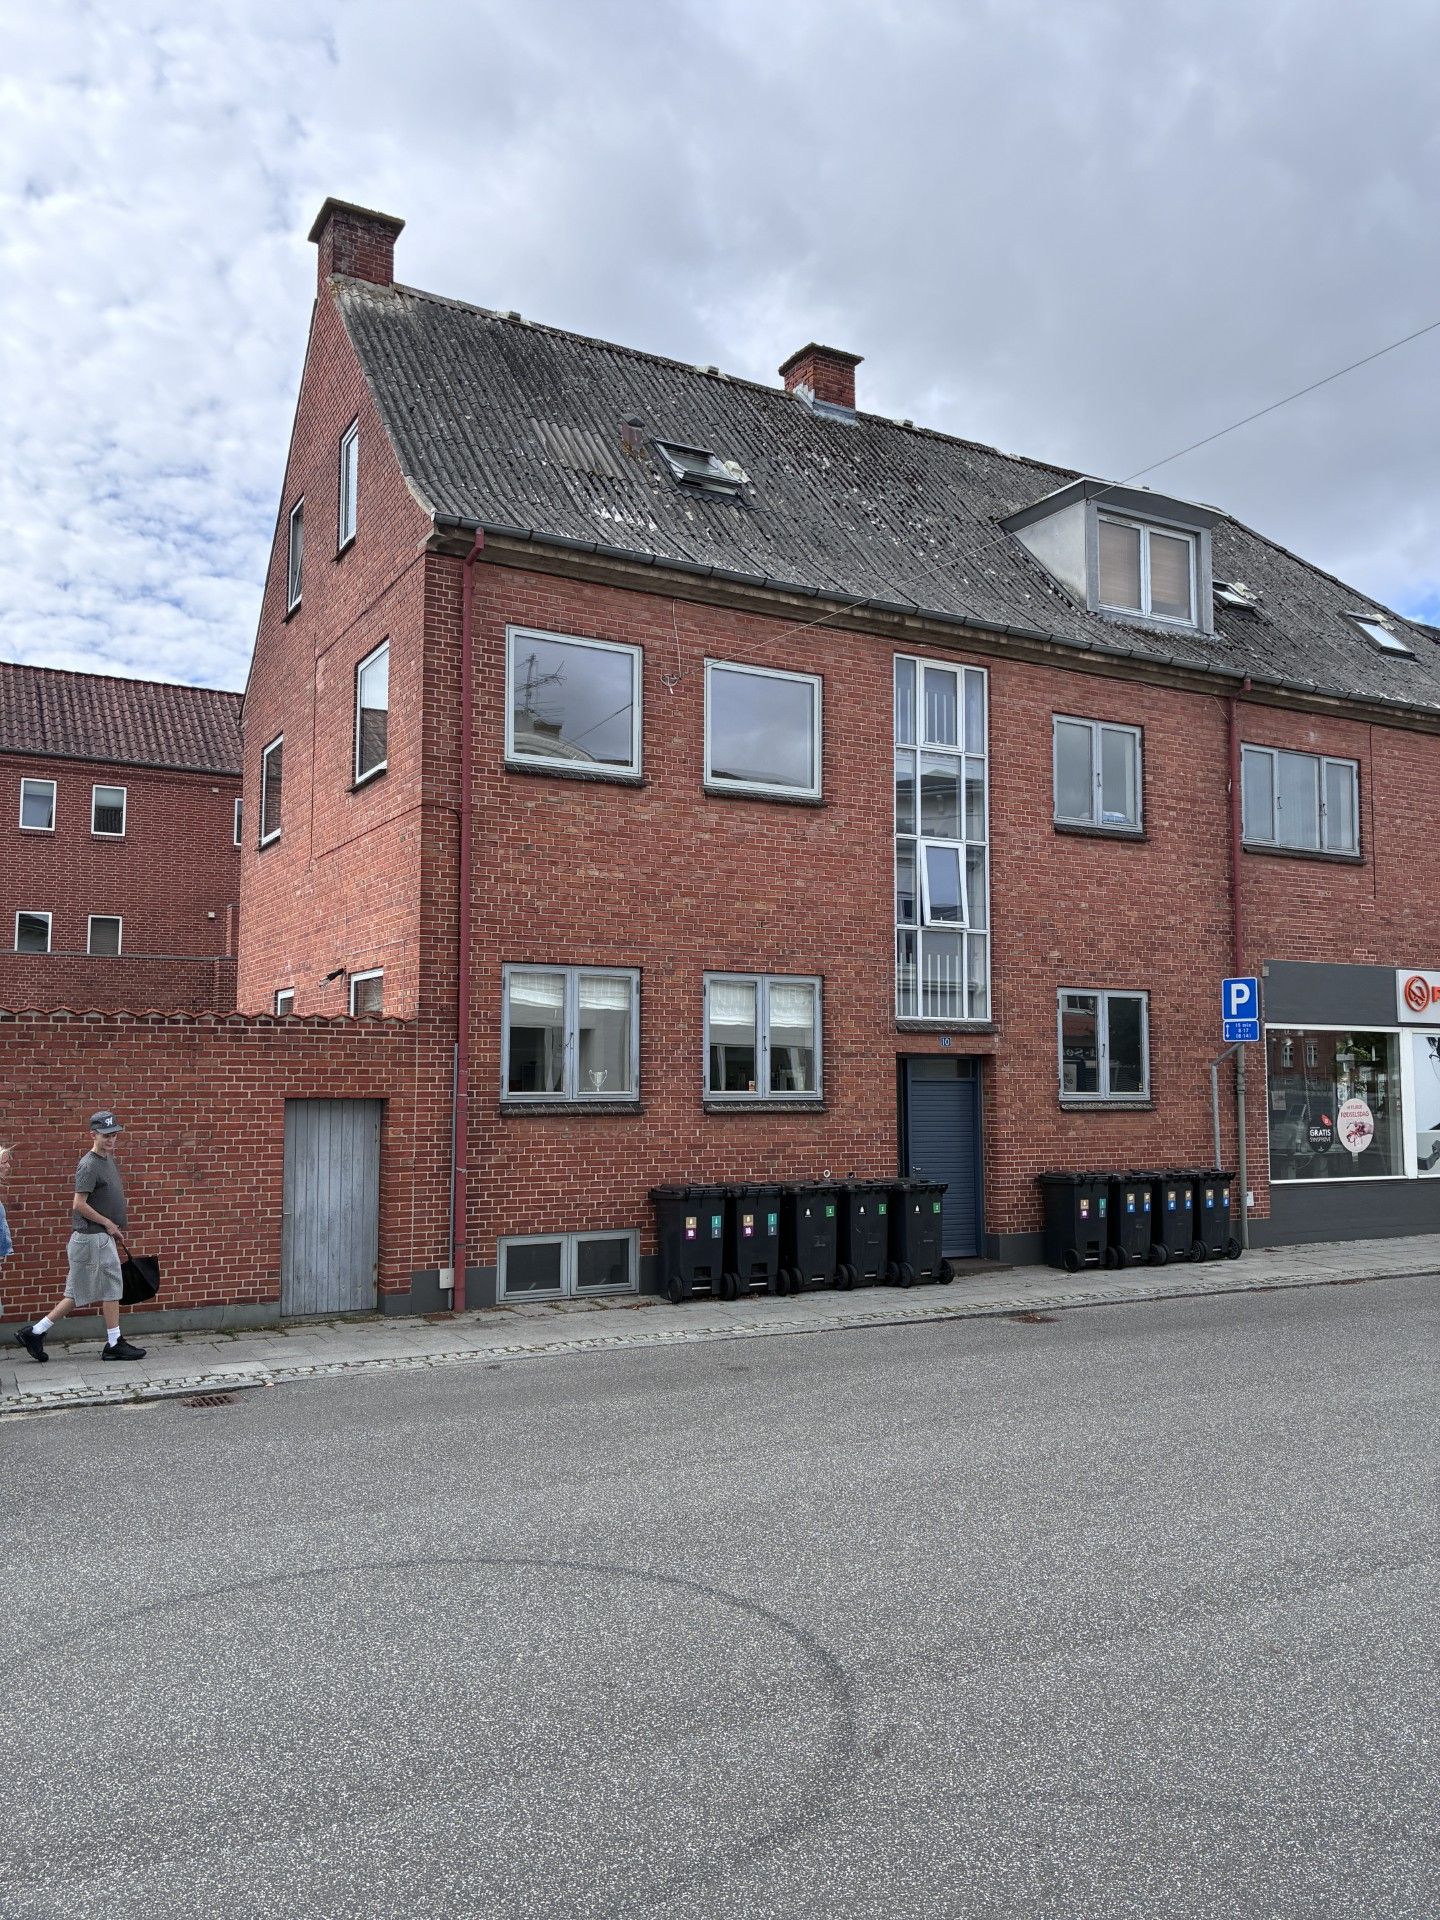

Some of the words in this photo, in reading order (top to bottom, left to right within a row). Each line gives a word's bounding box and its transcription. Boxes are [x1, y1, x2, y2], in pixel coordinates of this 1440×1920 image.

[1231, 983, 1250, 1015] P
[942, 1038, 950, 1046] 10
[1309, 1129, 1331, 1137] GRATIS
